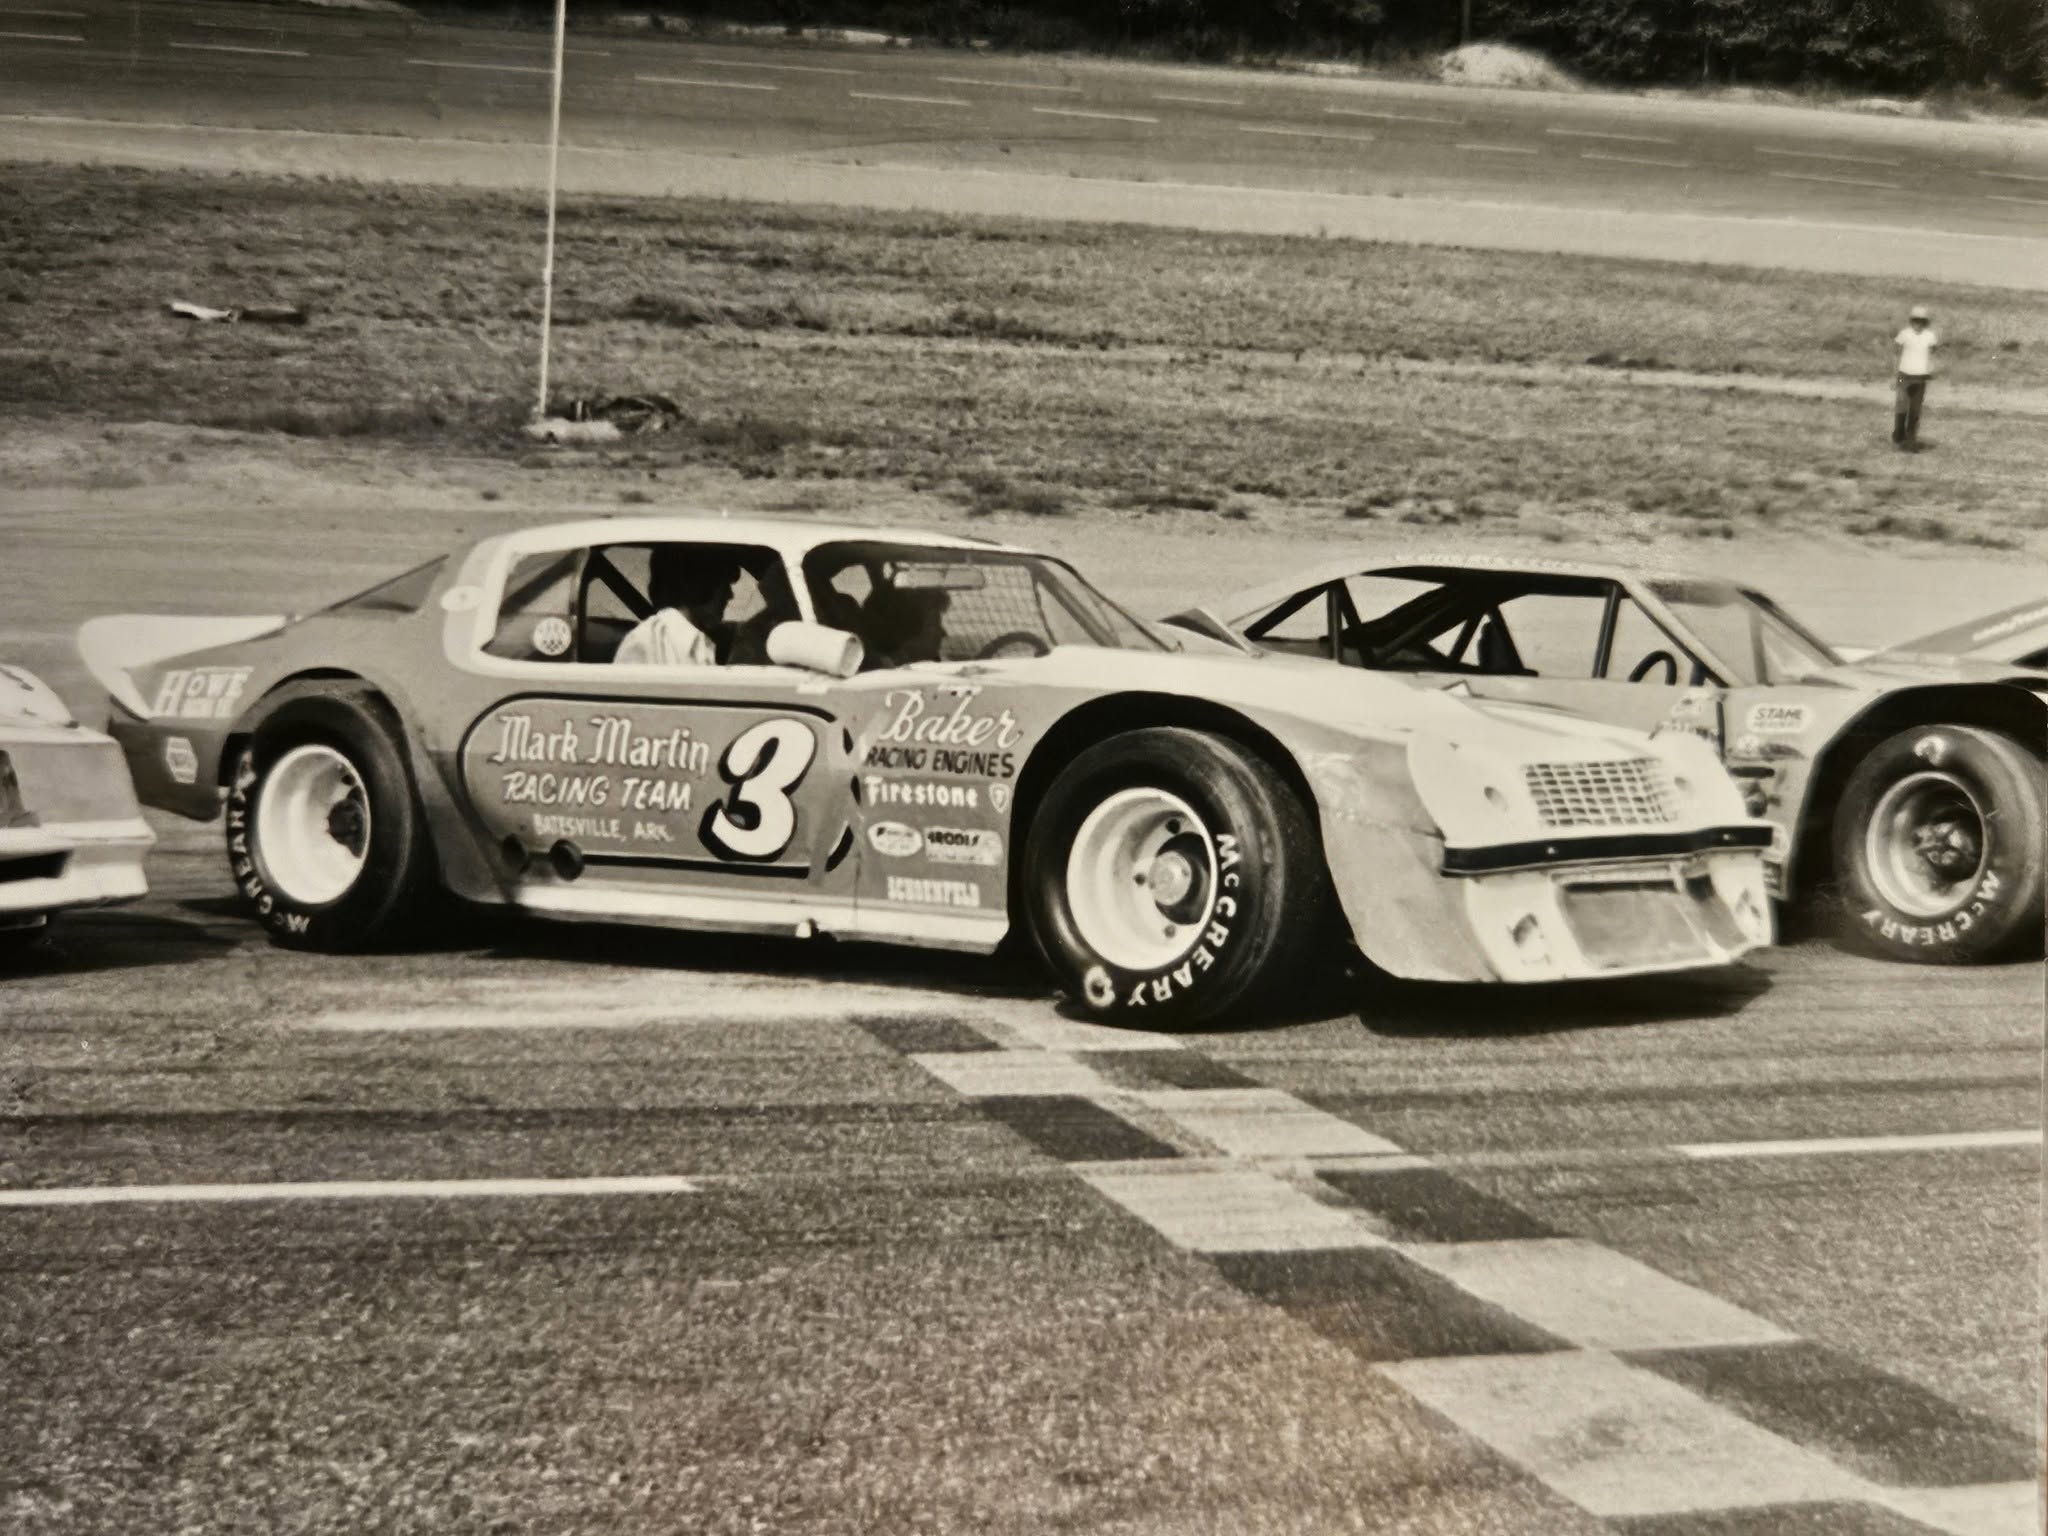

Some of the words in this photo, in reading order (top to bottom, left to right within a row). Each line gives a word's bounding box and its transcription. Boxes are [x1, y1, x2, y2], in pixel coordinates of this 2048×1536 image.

[878, 688, 1024, 749] Baker
[492, 715, 579, 763] Mark
[586, 716, 710, 776] Martin
[864, 745, 927, 770] RACING
[932, 749, 1015, 778] ENGINES
[503, 770, 611, 806] RACING
[622, 777, 692, 811] TEAM
[699, 717, 818, 862] 3
[864, 775, 978, 808] Firestone
